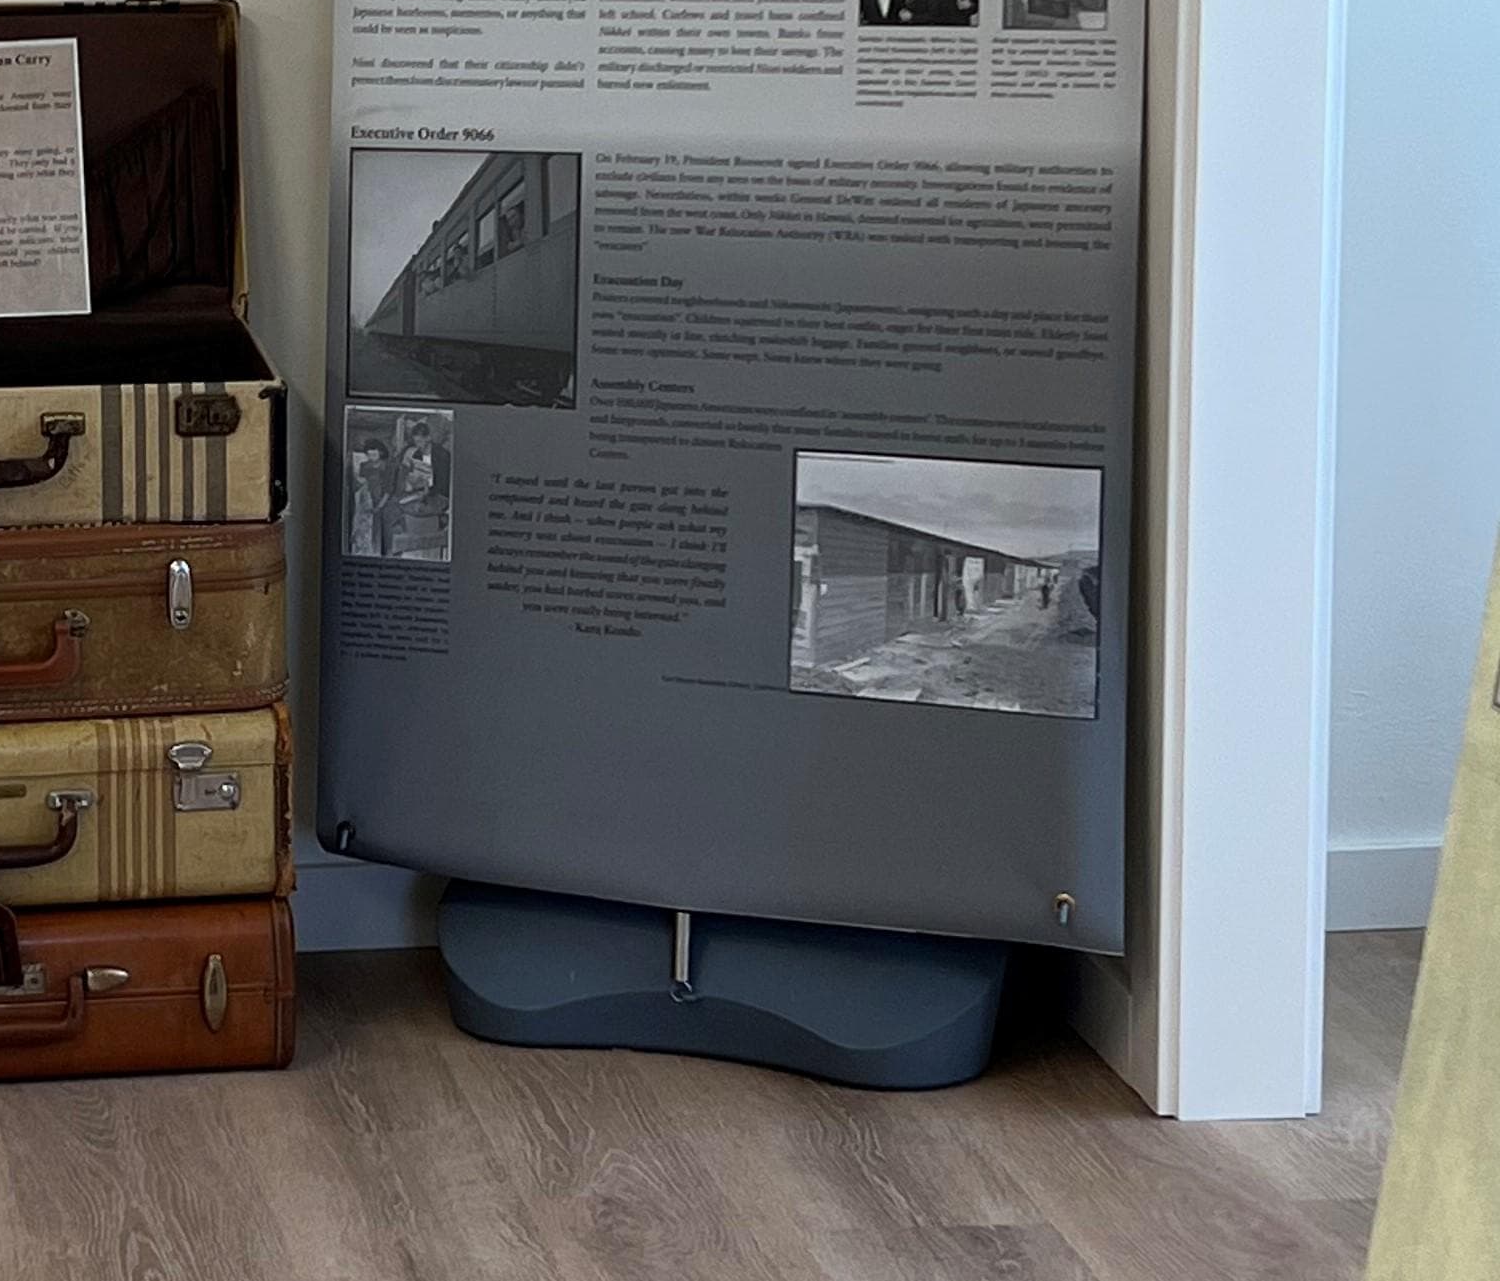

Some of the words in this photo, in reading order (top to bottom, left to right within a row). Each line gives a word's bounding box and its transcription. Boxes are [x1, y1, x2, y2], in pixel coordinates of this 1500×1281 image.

[15, 53, 52, 68] Carry
[350, 124, 414, 140] Executive
[417, 126, 458, 141] Order
[462, 127, 495, 142] 9066
[592, 273, 657, 287] Evacuation
[660, 275, 683, 290] Day
[591, 378, 645, 392] Assembly
[649, 381, 695, 393] Centers
